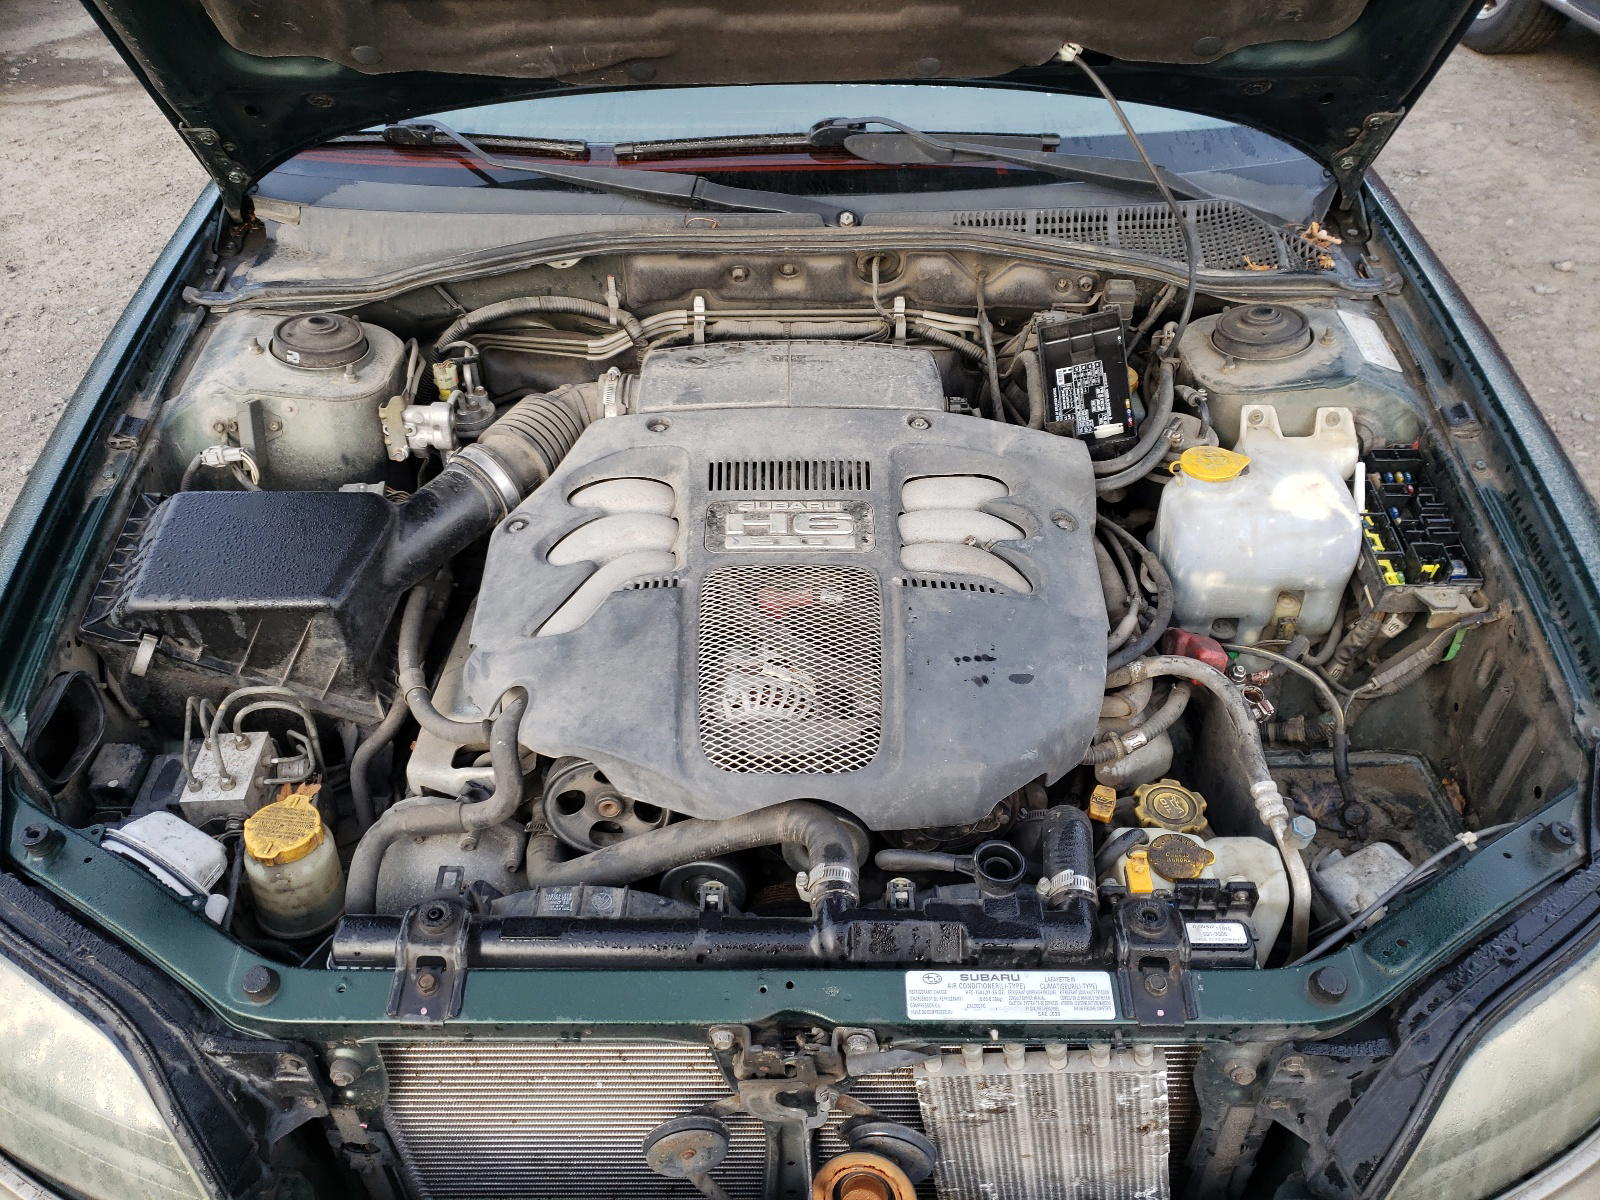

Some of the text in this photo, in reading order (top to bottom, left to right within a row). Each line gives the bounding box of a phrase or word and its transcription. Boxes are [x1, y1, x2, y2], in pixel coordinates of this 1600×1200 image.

[738, 501, 841, 511] SUBARU
[1159, 798, 1172, 814] OIL
[959, 973, 1021, 982] SUBARU
